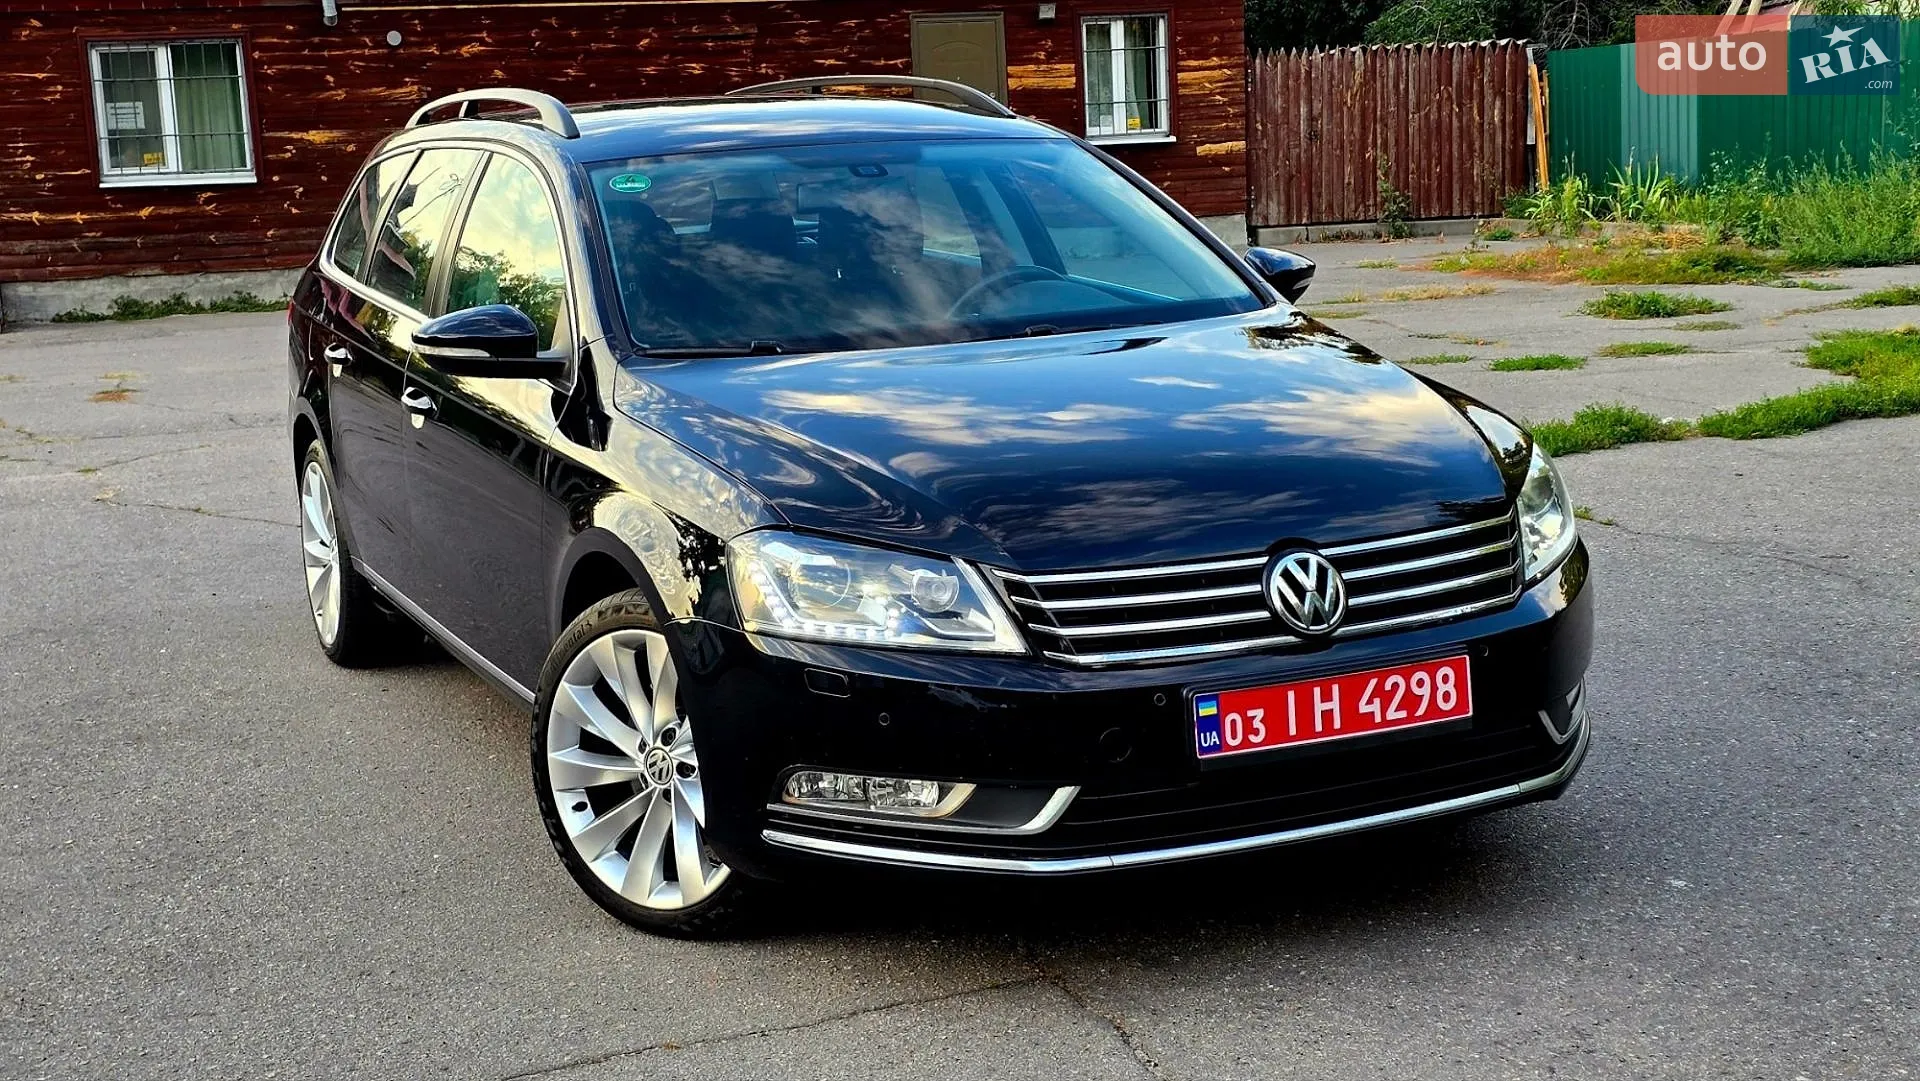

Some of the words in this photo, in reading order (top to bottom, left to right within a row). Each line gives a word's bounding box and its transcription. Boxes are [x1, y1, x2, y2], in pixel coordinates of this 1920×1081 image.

[1200, 731, 1220, 747] UA
[1224, 708, 1267, 747] 03
[1358, 666, 1457, 723] 4298
